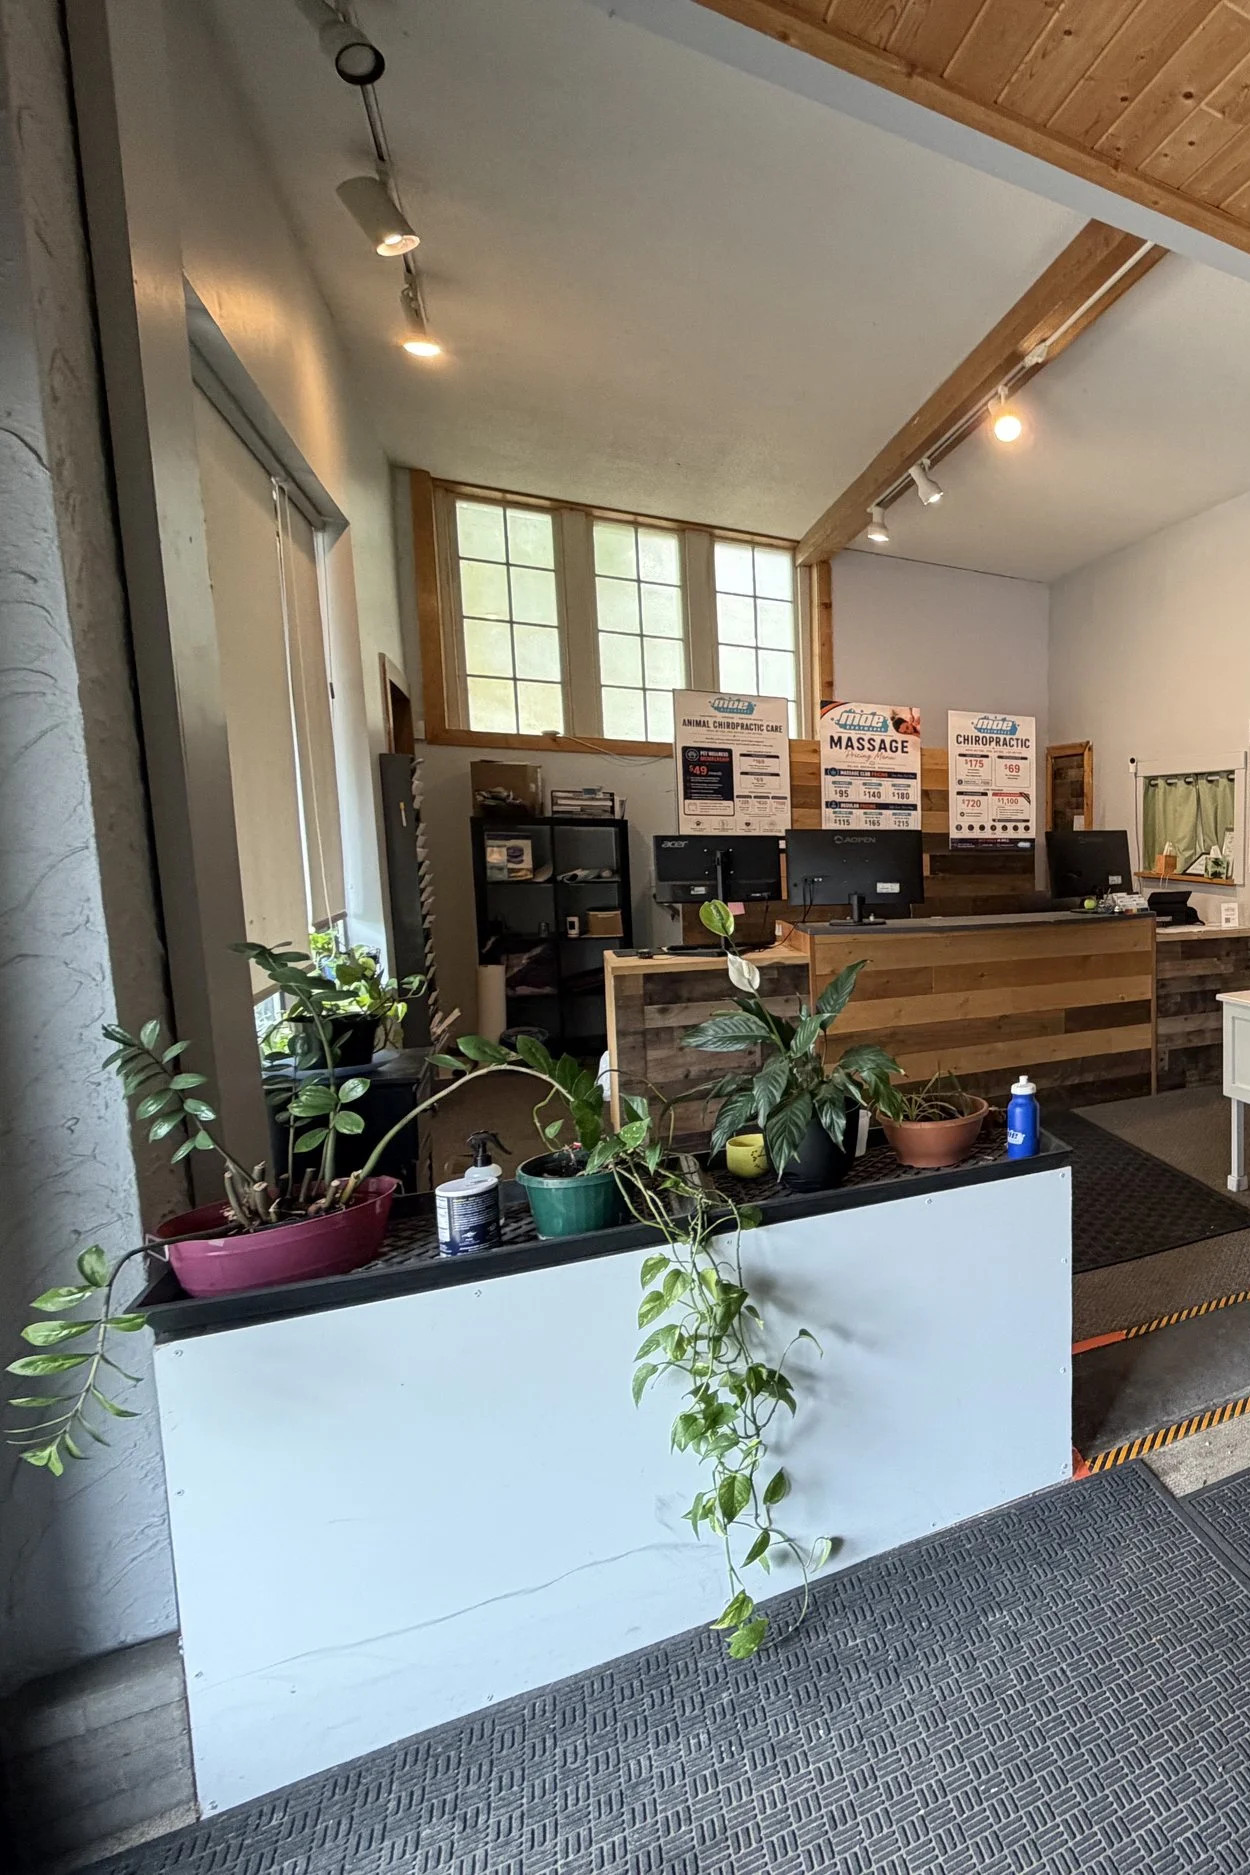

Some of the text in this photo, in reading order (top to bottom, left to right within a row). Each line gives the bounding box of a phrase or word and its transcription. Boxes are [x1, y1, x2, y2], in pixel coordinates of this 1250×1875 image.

[839, 712, 885, 727] moe
[682, 719, 711, 728] ANIMAL
[713, 721, 764, 732] CHIROPRACTIC
[766, 725, 783, 733] CARE
[976, 720, 1013, 730] moe
[829, 735, 909, 754] MASSAGE
[956, 734, 1030, 749] CHIROPRACTIC
[689, 765, 708, 775] $49
[964, 759, 1021, 773] $175 $69
[834, 790, 910, 800] $95 $140 $180
[962, 799, 981, 808] $720
[834, 818, 851, 826] $115
[864, 819, 881, 827] $165
[661, 840, 688, 848] acer
